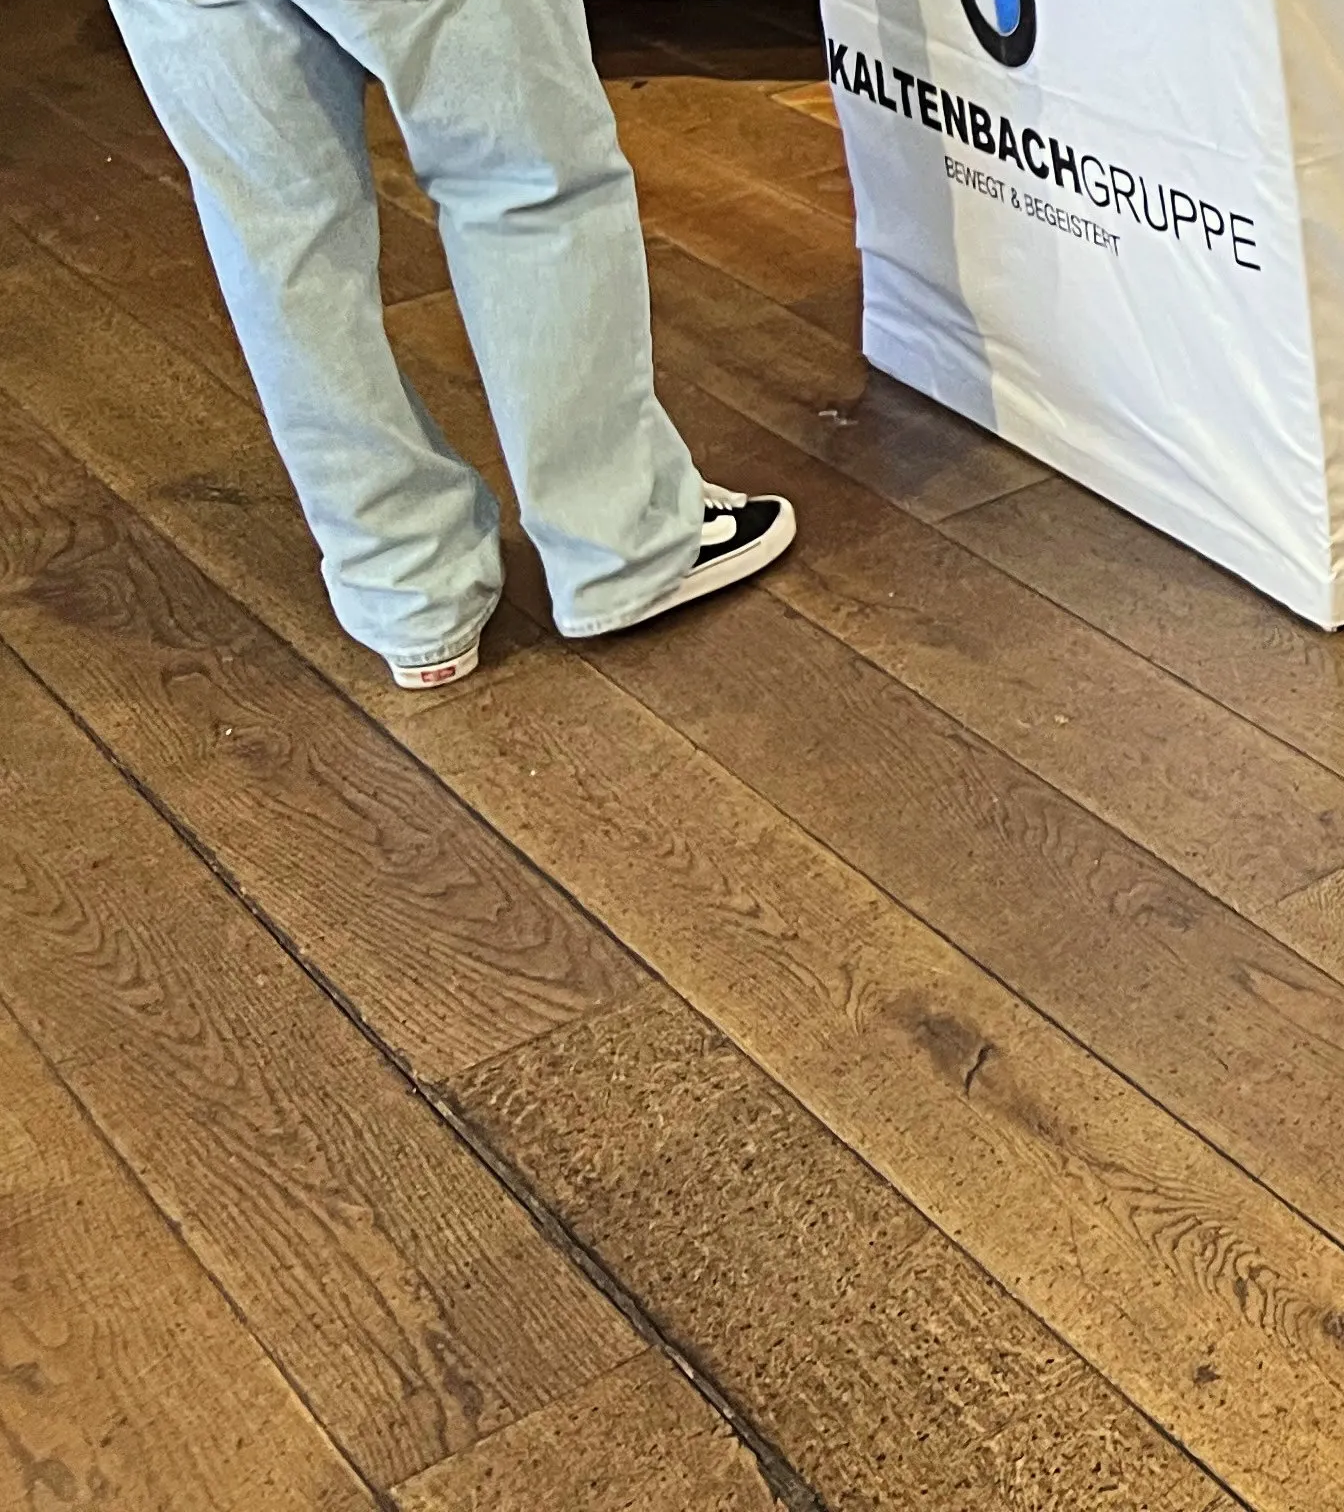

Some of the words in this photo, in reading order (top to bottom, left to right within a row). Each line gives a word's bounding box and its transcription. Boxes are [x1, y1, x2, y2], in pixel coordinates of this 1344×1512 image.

[826, 37, 1262, 272] KALTENBACHGRUPPE
[944, 155, 1006, 204] BEWEGT
[1010, 187, 1021, 210] &
[1023, 193, 1121, 257] BEGEISTERT
